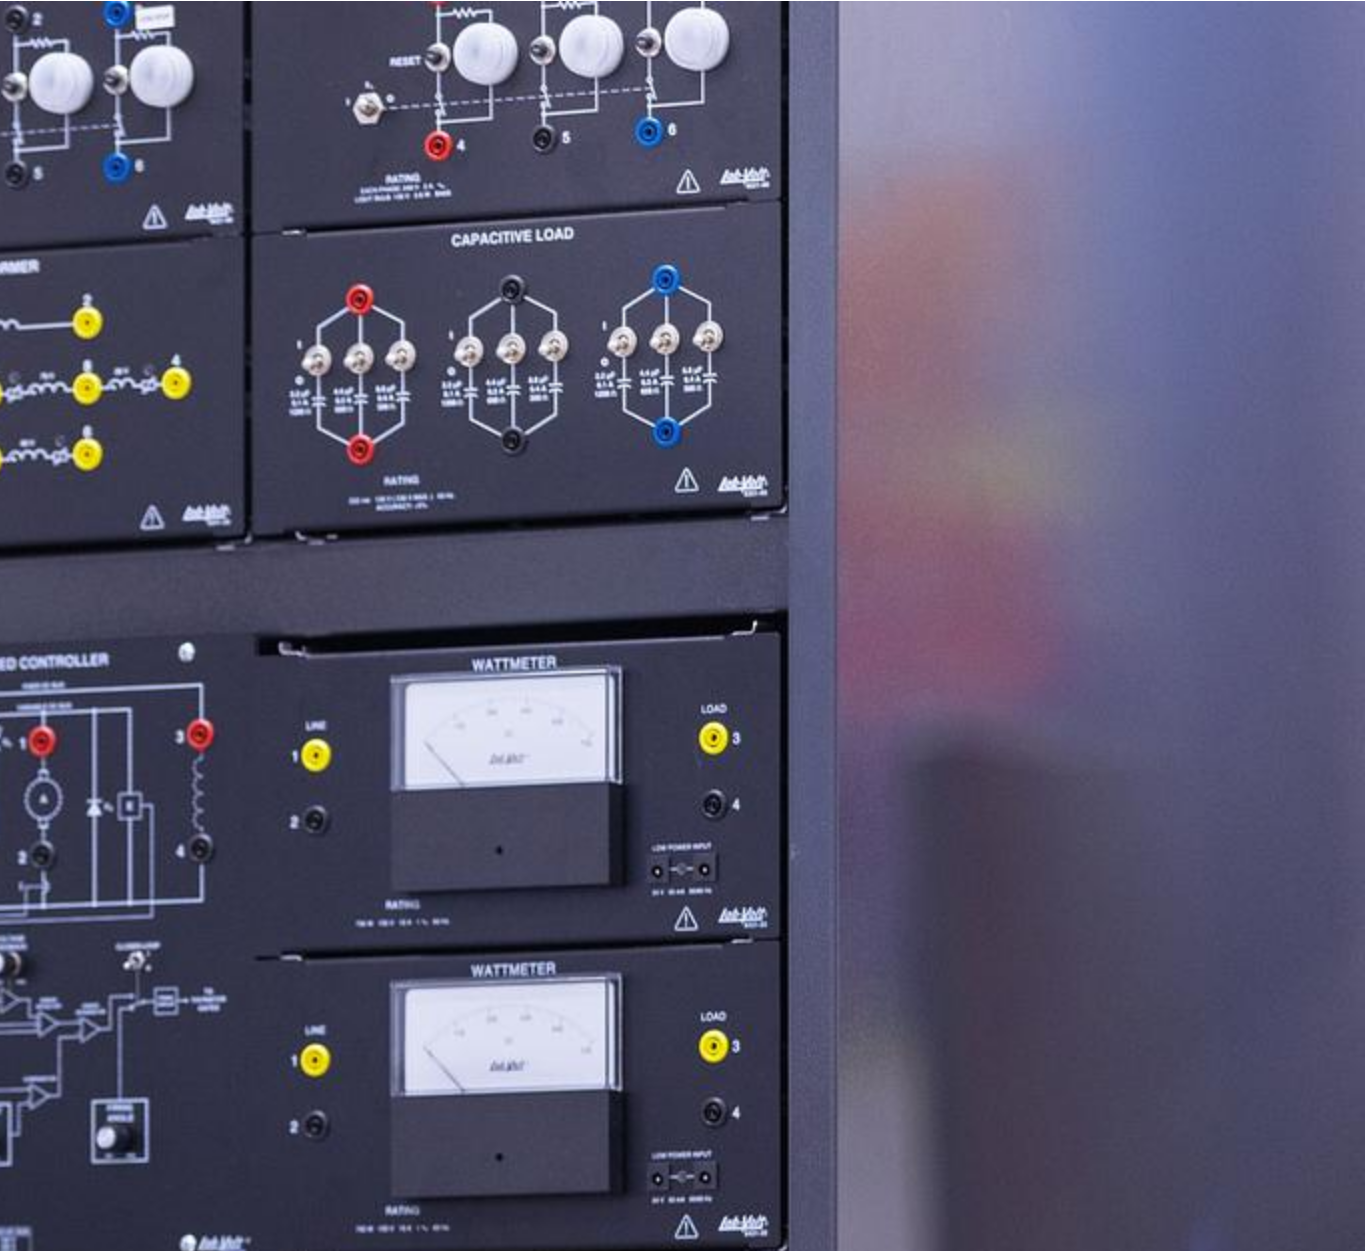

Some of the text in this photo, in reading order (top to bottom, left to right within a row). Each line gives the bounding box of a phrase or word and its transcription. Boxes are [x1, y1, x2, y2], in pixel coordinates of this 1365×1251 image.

[390, 55, 421, 66] RESET
[668, 123, 677, 135] 6
[562, 131, 570, 143] 5
[457, 139, 465, 151] 4
[451, 227, 574, 247] CAPACITIVE LOAD
[384, 475, 419, 485] RATING
[19, 652, 109, 671] CONTROLLER
[470, 655, 559, 673] WATTMETER
[701, 704, 727, 714] LOAD
[306, 721, 326, 731] LINE
[733, 732, 741, 745] 3
[292, 750, 298, 762] 1
[733, 799, 740, 810] 4
[290, 815, 299, 829] 2
[470, 961, 558, 979] WATTMETER
[701, 1011, 727, 1022] LOAD
[305, 1025, 325, 1035] LINE
[732, 1040, 740, 1053] 3
[732, 1107, 740, 1118] 4
[290, 1120, 299, 1133] 2
